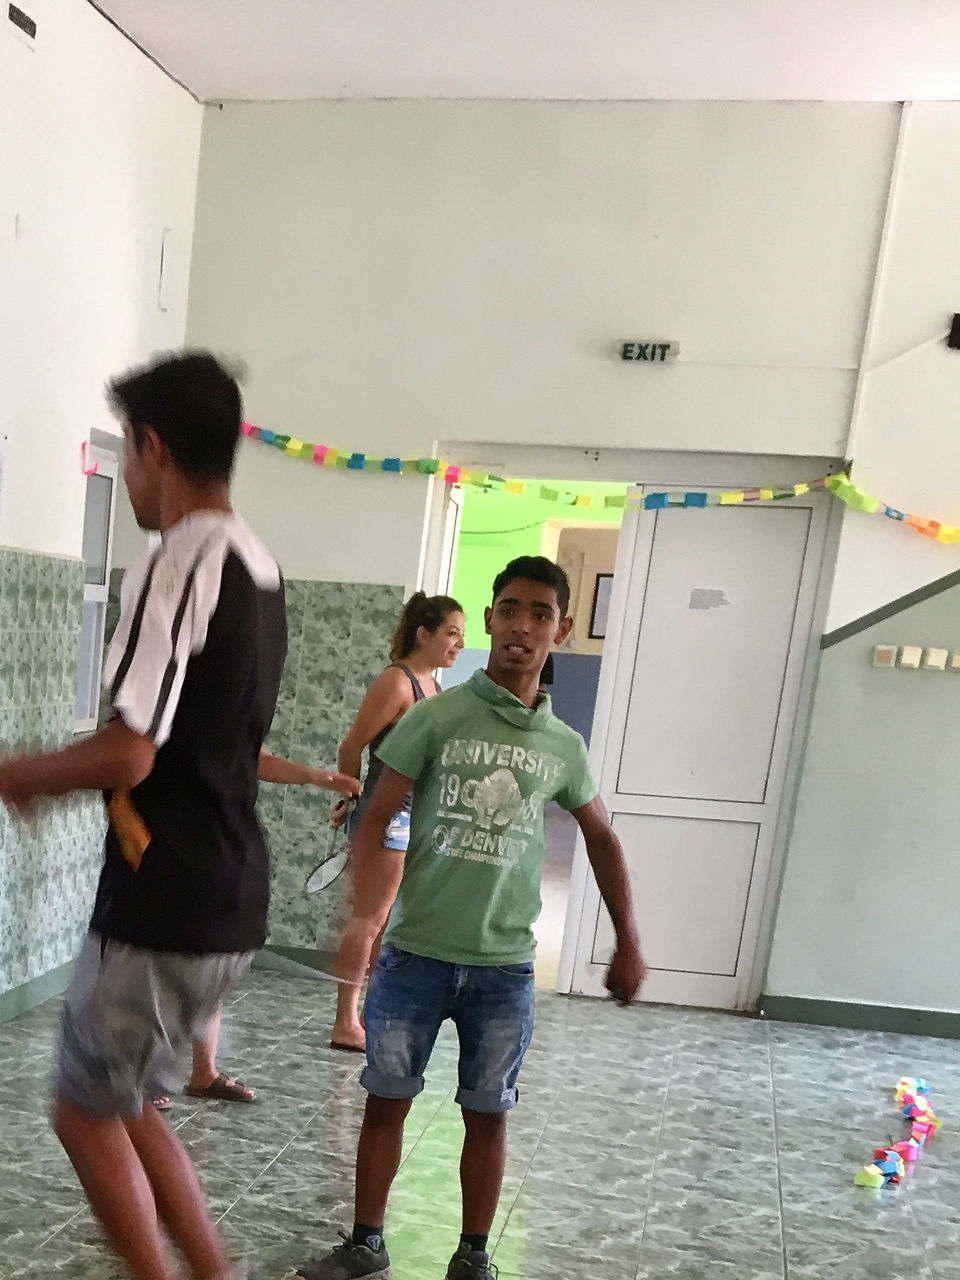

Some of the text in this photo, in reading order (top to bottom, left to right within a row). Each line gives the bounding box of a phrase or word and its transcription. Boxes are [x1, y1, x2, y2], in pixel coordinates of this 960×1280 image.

[622, 343, 670, 361] EXIT
[441, 738, 566, 783] UNIVERSITY
[439, 773, 460, 807] 19
[431, 825, 460, 856] OF
